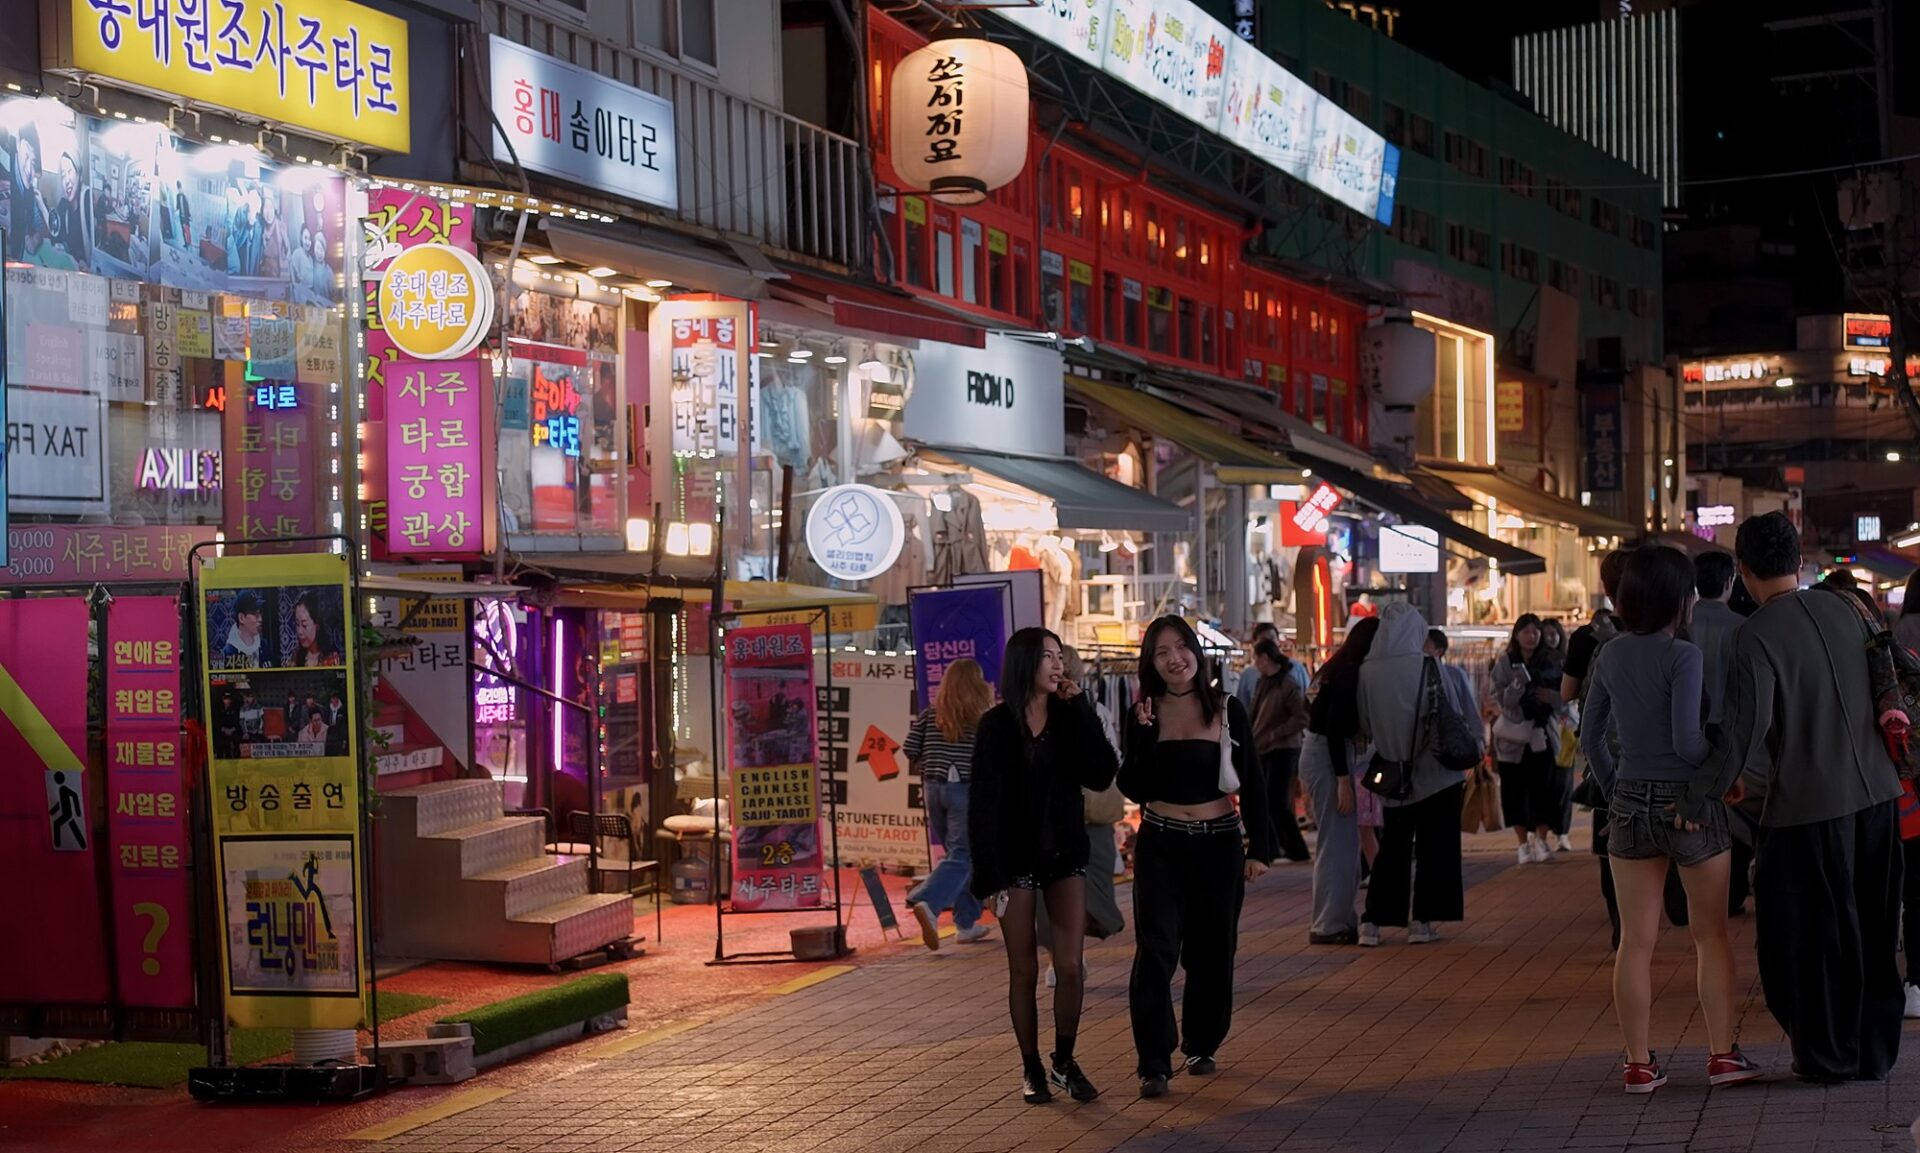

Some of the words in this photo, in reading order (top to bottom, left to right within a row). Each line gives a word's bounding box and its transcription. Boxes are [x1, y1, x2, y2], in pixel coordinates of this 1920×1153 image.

[514, 78, 561, 144] 홍대
[570, 99, 660, 171] 솜이타로
[389, 271, 469, 299] 홍대원조
[389, 300, 467, 330] 사주타로
[257, 386, 297, 410] 타로
[399, 371, 467, 407] 사주
[1005, 378, 1014, 408] D
[400, 418, 469, 453] 타로
[548, 416, 580, 457] 타로
[400, 463, 470, 498] 궁합
[401, 511, 471, 546] 관상
[114, 641, 172, 665] 연애운
[924, 640, 975, 660] 당신의
[832, 662, 861, 678] 홍대
[115, 690, 174, 713] 취업운
[116, 742, 175, 766] 재물운
[741, 769, 810, 783] ENGLISH
[741, 783, 809, 796] CHINESE
[117, 793, 175, 817] 사업운
[741, 795, 810, 809] JAPANESE
[119, 844, 178, 868] 진로운
[761, 843, 796, 866] 2층
[738, 875, 818, 900] 사주타로
[246, 901, 318, 977] 런닝맨
